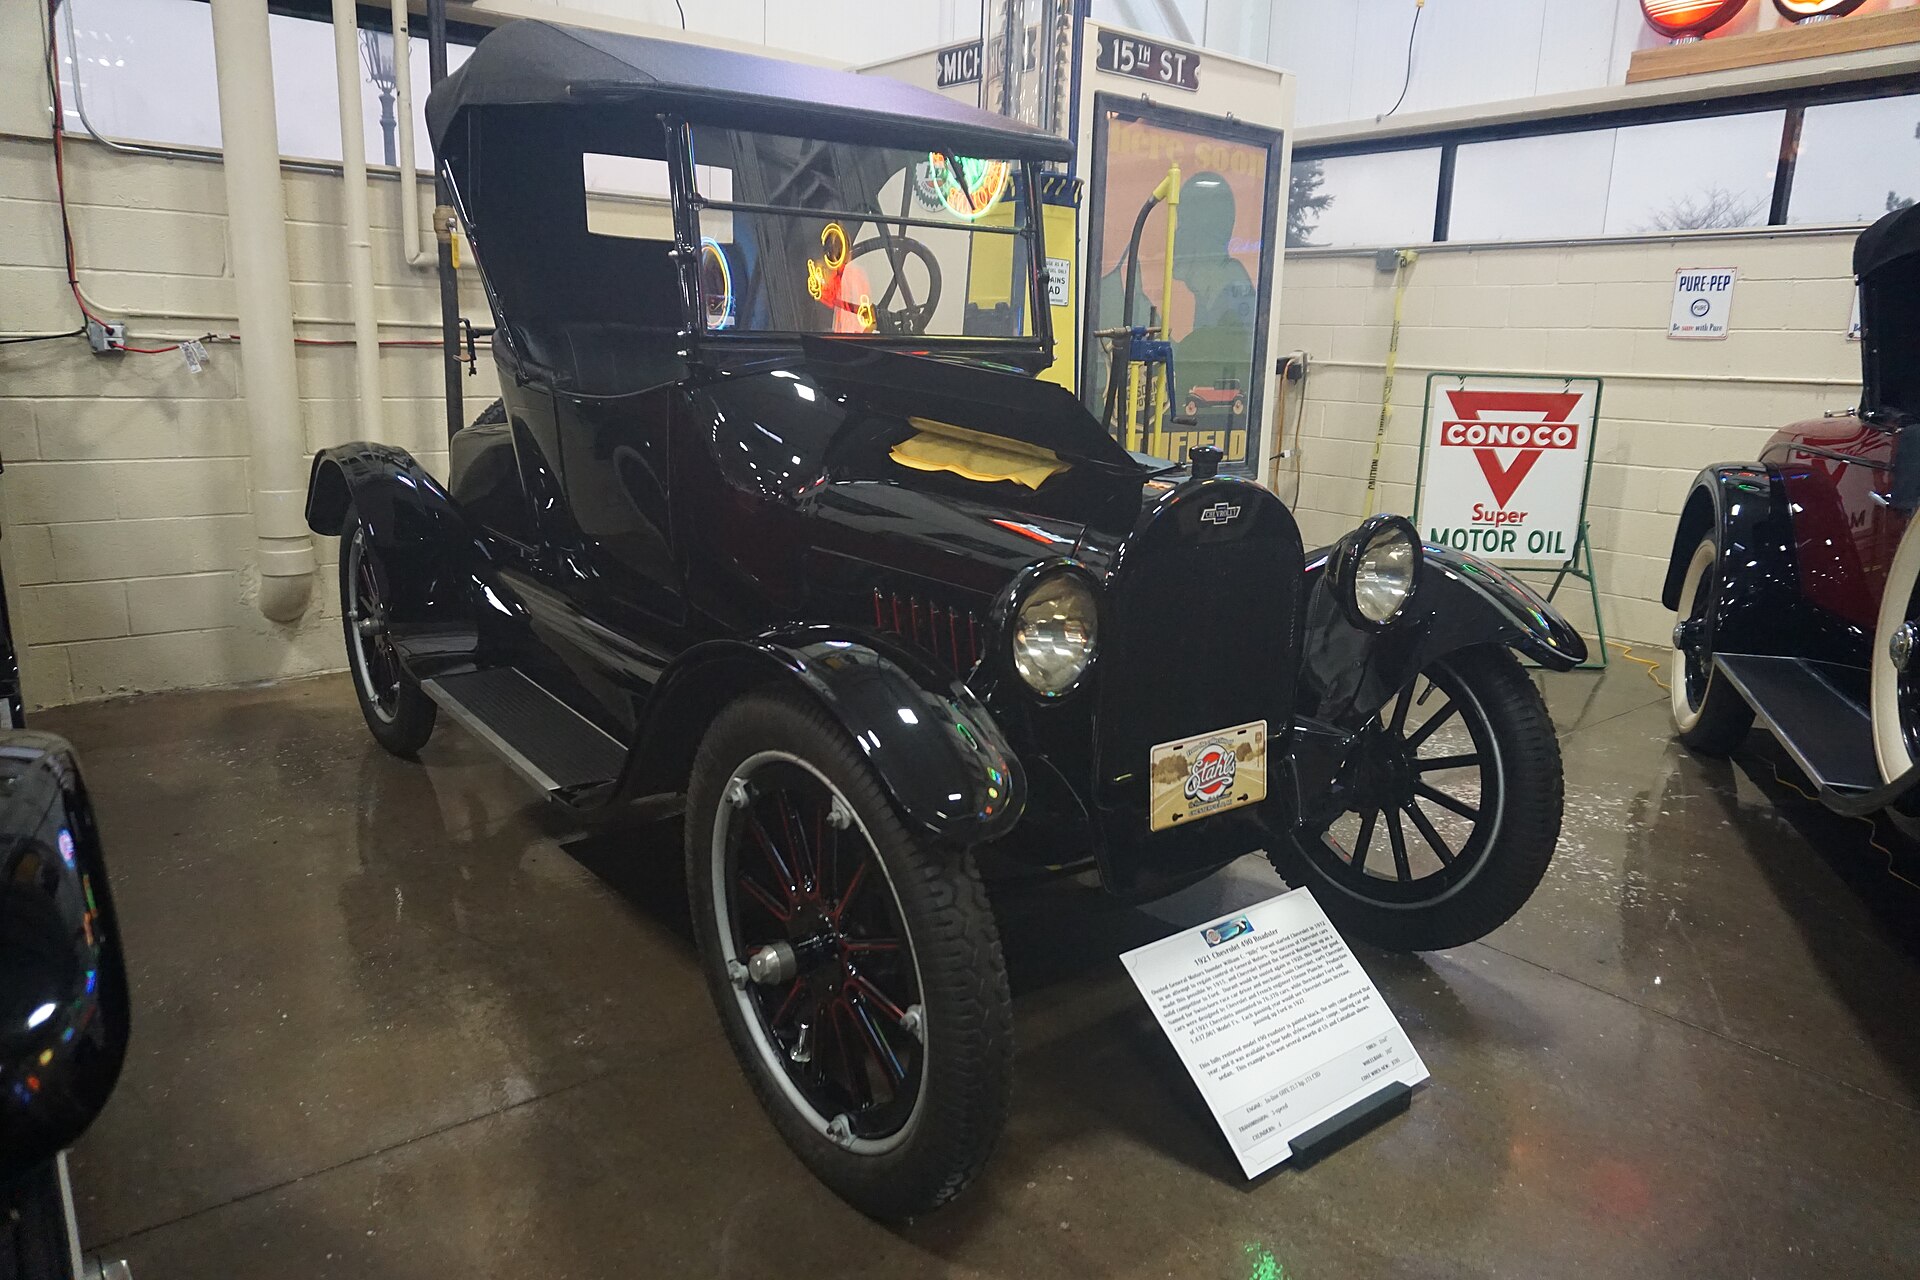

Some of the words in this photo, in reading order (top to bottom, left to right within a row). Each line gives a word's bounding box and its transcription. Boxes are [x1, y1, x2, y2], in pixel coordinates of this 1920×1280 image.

[1160, 50, 1186, 84] ST.
[1679, 275, 1731, 292] PURE-PEP
[1710, 323, 1722, 332] Pure
[1446, 424, 1572, 447] CONOCO
[1472, 503, 1528, 528] Super
[1430, 528, 1518, 552] MOTOR
[1528, 530, 1566, 554] OIL
[1168, 977, 1188, 988] General
[1188, 971, 1205, 980] Motors
[1260, 942, 1275, 951] Durant
[1290, 928, 1309, 939] Chevrolet
[1194, 955, 1211, 966] 1921
[1212, 944, 1240, 959] Chevrolet
[1241, 938, 1253, 947] 490
[1253, 929, 1278, 942] Roadster
[1234, 960, 1252, 970] General
[1299, 932, 1319, 943] Chevrolet
[1325, 946, 1344, 957] Chevrolet
[1236, 966, 1258, 978] Chevrolet
[1279, 950, 1296, 960] General
[1295, 945, 1310, 953] Motors
[1222, 983, 1238, 993] Durant
[1302, 982, 1322, 993] Chevrolet
[1226, 997, 1248, 1009] Chevrolet
